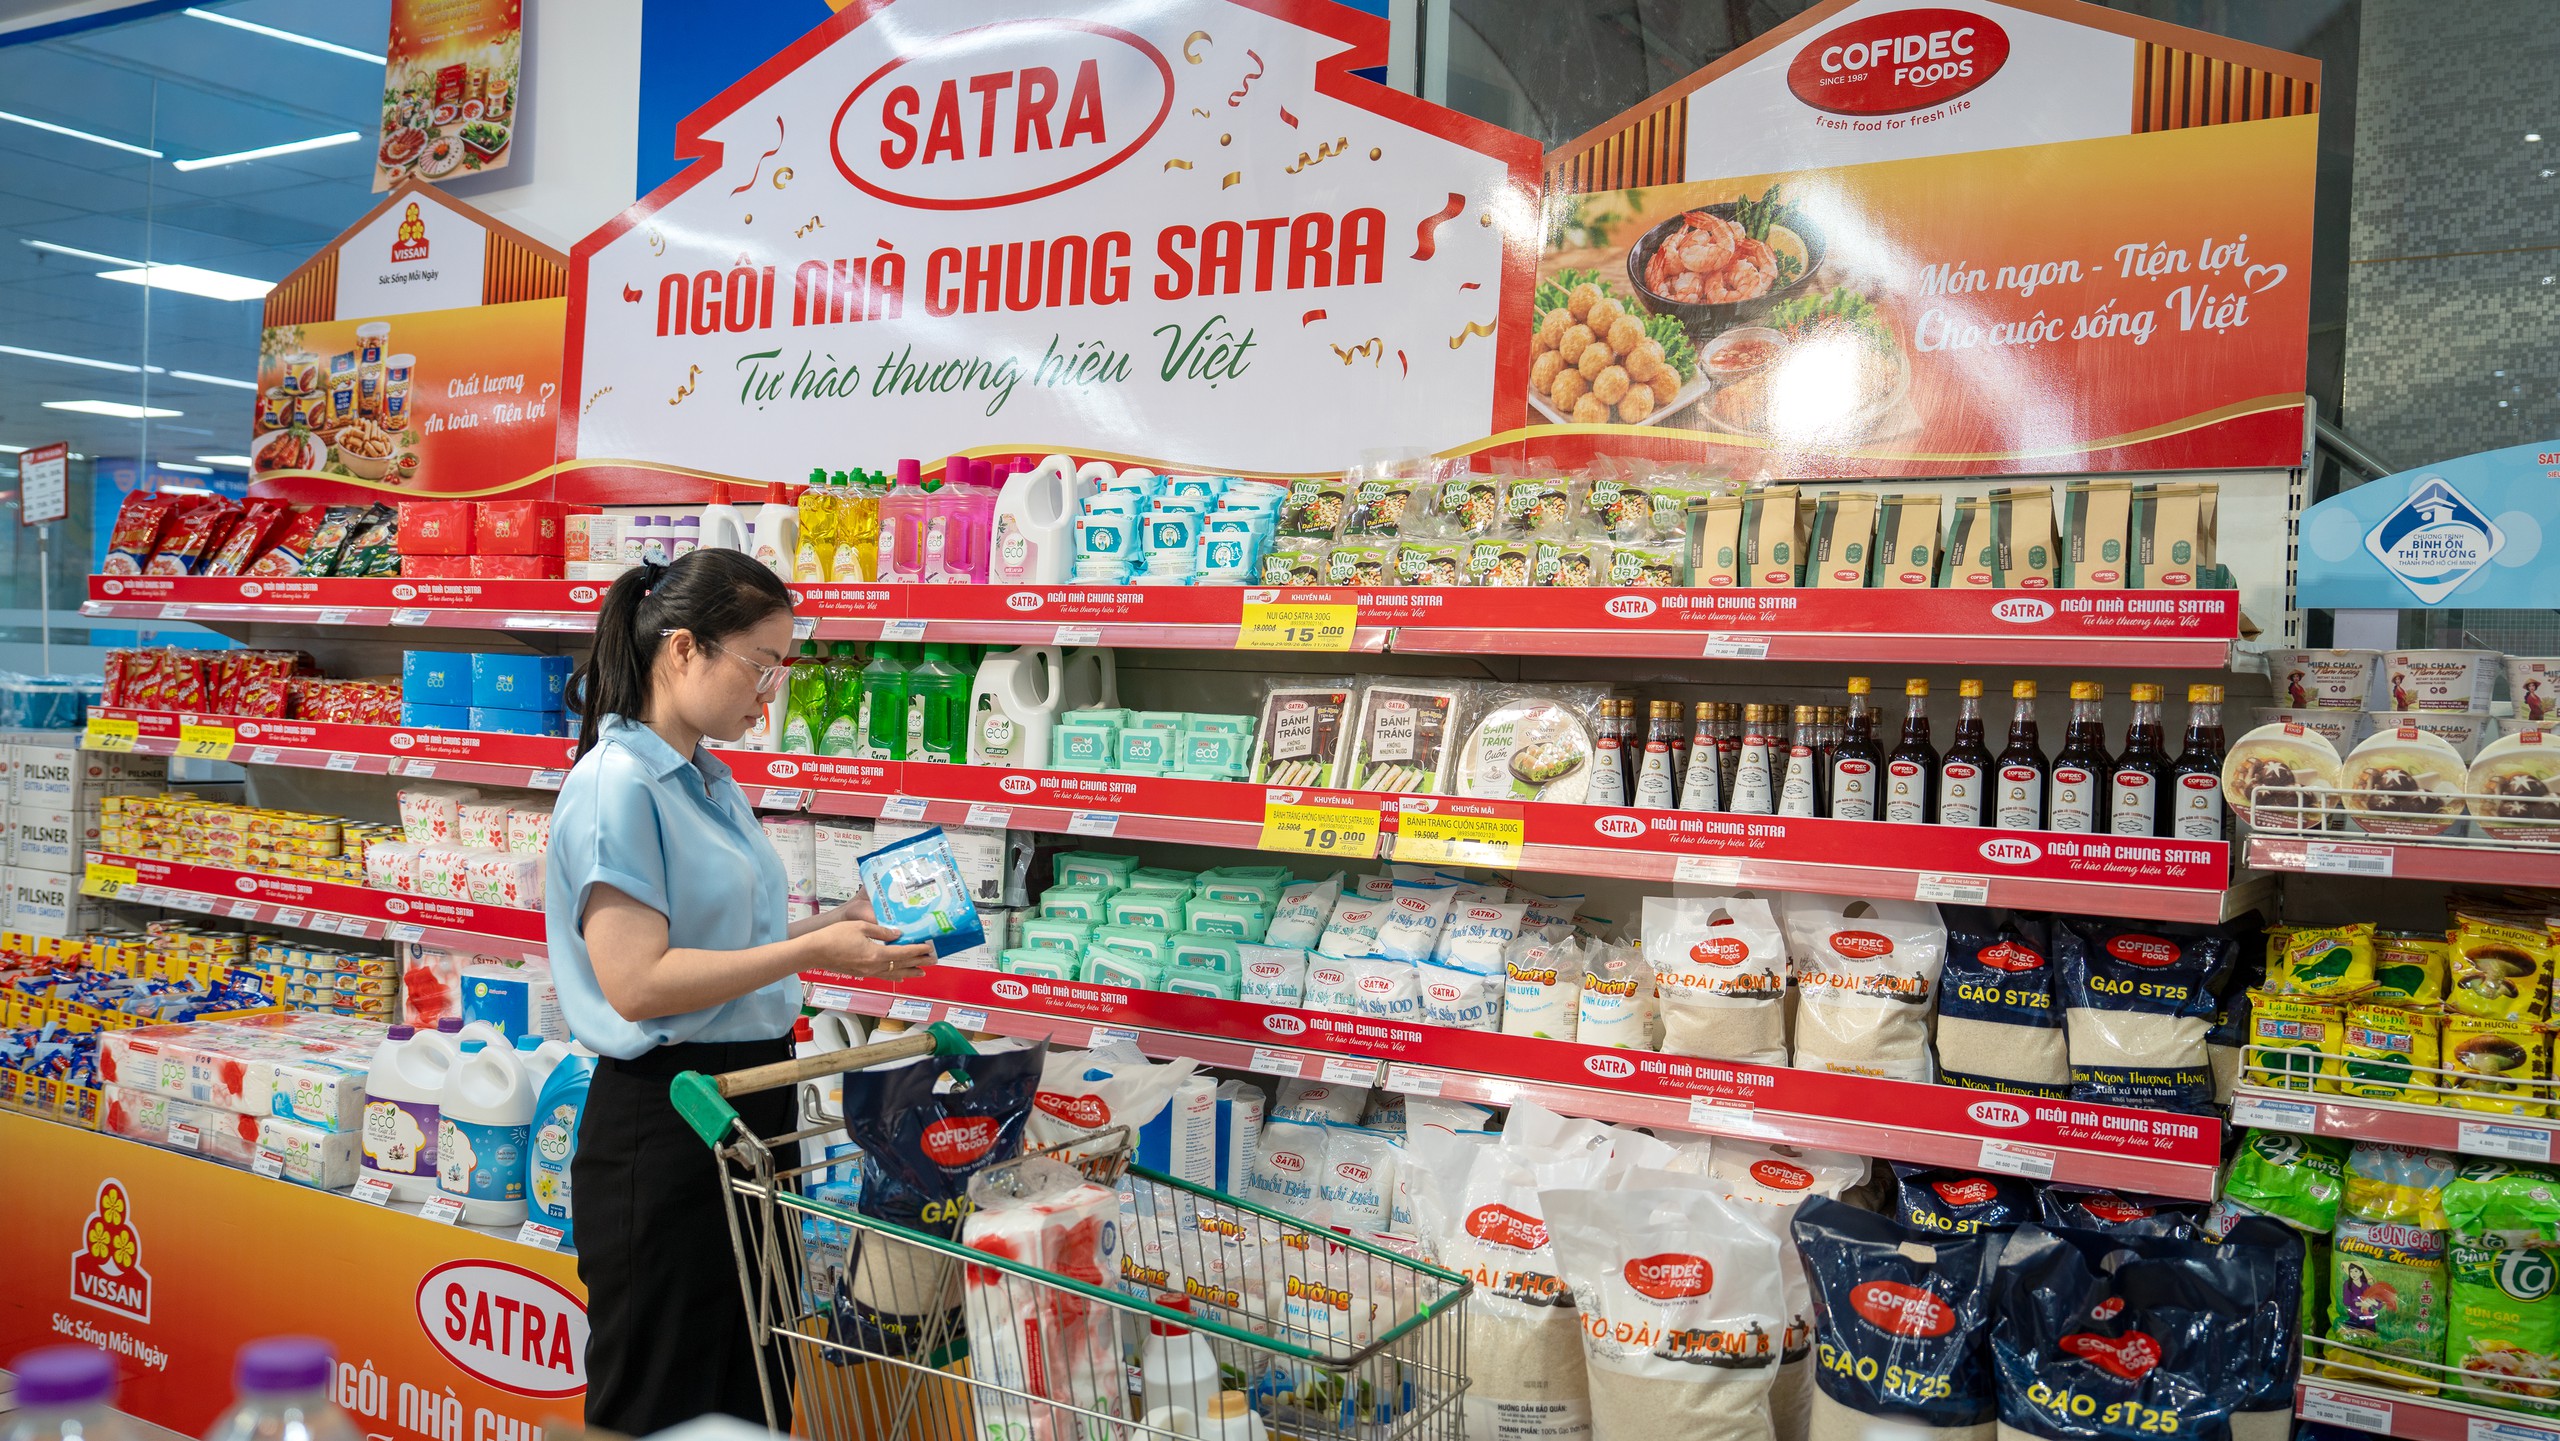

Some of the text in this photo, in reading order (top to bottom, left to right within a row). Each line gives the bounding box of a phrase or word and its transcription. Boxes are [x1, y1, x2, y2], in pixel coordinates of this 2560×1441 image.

[1821, 28, 1975, 73] COFIDEC
[1819, 73, 1868, 87] SINCE 1987
[1894, 59, 1973, 86] FOODS
[878, 58, 1108, 172] SATRA
[1816, 101, 1971, 132] fresh food for fresh life
[393, 247, 427, 261] VISSAN
[655, 205, 1387, 338] NGÔI NHÀ CHUNG SATRA
[1919, 233, 2250, 298] Món ngon Tiện lợi
[378, 269, 439, 285] Sức Sống Mỗi Ngày
[1914, 284, 2250, 352] Cho cuộc sống Việt
[735, 314, 1262, 418] Tự hào thương hiệu Việt
[447, 371, 525, 399] Chất lượng
[424, 400, 546, 436] An toàn Tiện lợi
[2412, 537, 2463, 549] BÌNH ỔN
[2398, 549, 2476, 560] THỊ TRƯỜNG
[1268, 556, 1291, 571] Nui
[1265, 570, 1292, 585] gạo
[1292, 593, 1317, 601] KHUYẾN
[2061, 597, 2225, 613] NGÔI NHÀ CHUNG SATRA
[1267, 612, 1277, 620] NUI
[1279, 612, 1293, 621] GẠO
[1294, 612, 1312, 620] SATRA
[2000, 604, 2045, 617] SATRA
[2082, 614, 2201, 629] Tự hào thương hiệu Việt
[1284, 628, 1314, 642] 15
[1280, 713, 1310, 727] BÁNH
[1380, 715, 1411, 727] BÁNH
[102, 733, 121, 747] 27
[1277, 725, 1311, 739] TRÁNG
[1376, 725, 1413, 739] TRÁNG
[195, 740, 217, 754] 27
[24, 763, 70, 781] PILSNER
[23, 782, 71, 793] EXTRA SMOOTH
[1004, 779, 1031, 790] SATRA
[1040, 776, 1136, 793] NGÔI NHÀ CHUNG SATRA
[1314, 796, 1338, 804] KHUYẾN
[1451, 804, 1478, 813] KHUYẾN
[1406, 817, 1518, 832] BÁNH TRÁNG CUỐN SATRA 300G
[1304, 829, 1365, 849] 19 .000
[1988, 843, 2031, 858] SATRA
[2048, 841, 2211, 864] NGÔI NHÀ CHUNG SATRA
[2069, 859, 2187, 877] Tự hào thương hiệu Việt
[100, 879, 120, 893] 26
[2117, 938, 2171, 955] COFIDEC
[1987, 948, 2036, 964] COFIDEC
[2007, 958, 2034, 968] FOODS
[2142, 951, 2170, 961] FOODS
[2089, 975, 2188, 1000] GẠO ST25
[1958, 984, 2050, 1008] GẠO ST25
[2133, 1085, 2152, 1097] Việt
[2155, 1087, 2177, 1097] Nam
[1976, 1105, 2020, 1123] SATRA
[2036, 1107, 2198, 1139] NGÔI NHÀ CHUNG SATRA
[2057, 1125, 2175, 1150] Tự hào thương hiệu Việt
[1275, 1154, 1301, 1169] SATRA
[2368, 1225, 2442, 1252] BÚN GẠO
[80, 1272, 142, 1310] VISSAN
[1866, 1286, 1941, 1320] COFIDEC
[445, 1282, 575, 1375] SATRA
[1899, 1312, 1938, 1332] FOODS
[52, 1312, 168, 1372] Sức Sống Mỗi Ngày
[1615, 1320, 1771, 1354] ĐÀI THƠM 8
[1818, 1342, 1952, 1399] GẠO ST25
[398, 1385, 463, 1441] NHÀ
[474, 1407, 542, 1441] CHU
[2026, 1382, 2179, 1434] GẠO ST25
